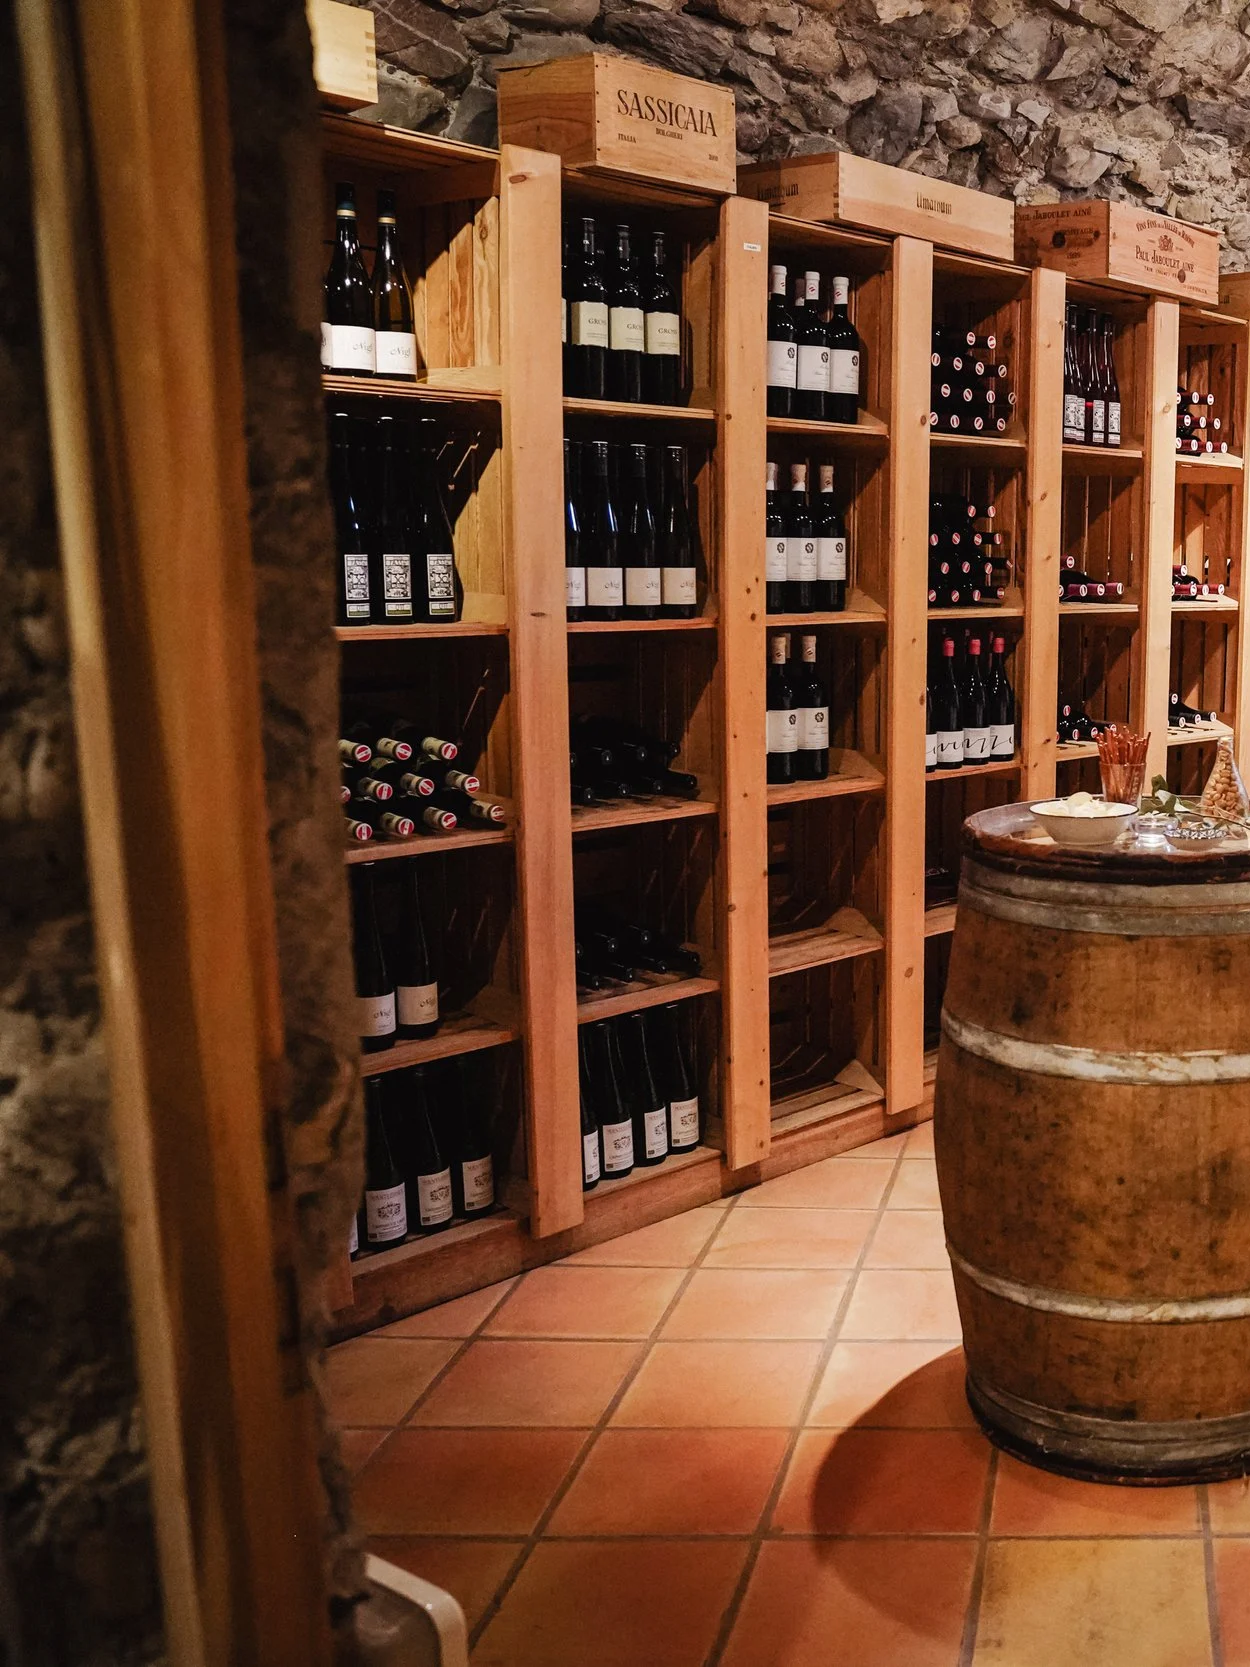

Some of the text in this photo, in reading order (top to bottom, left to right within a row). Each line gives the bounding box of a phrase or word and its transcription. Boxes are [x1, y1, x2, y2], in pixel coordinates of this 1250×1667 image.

[617, 89, 717, 137] SASSICAIA
[618, 133, 637, 144] ITALIA
[1033, 209, 1071, 220] JABOULET
[1135, 245, 1149, 262] PAUL
[1151, 249, 1180, 269] JABOULET
